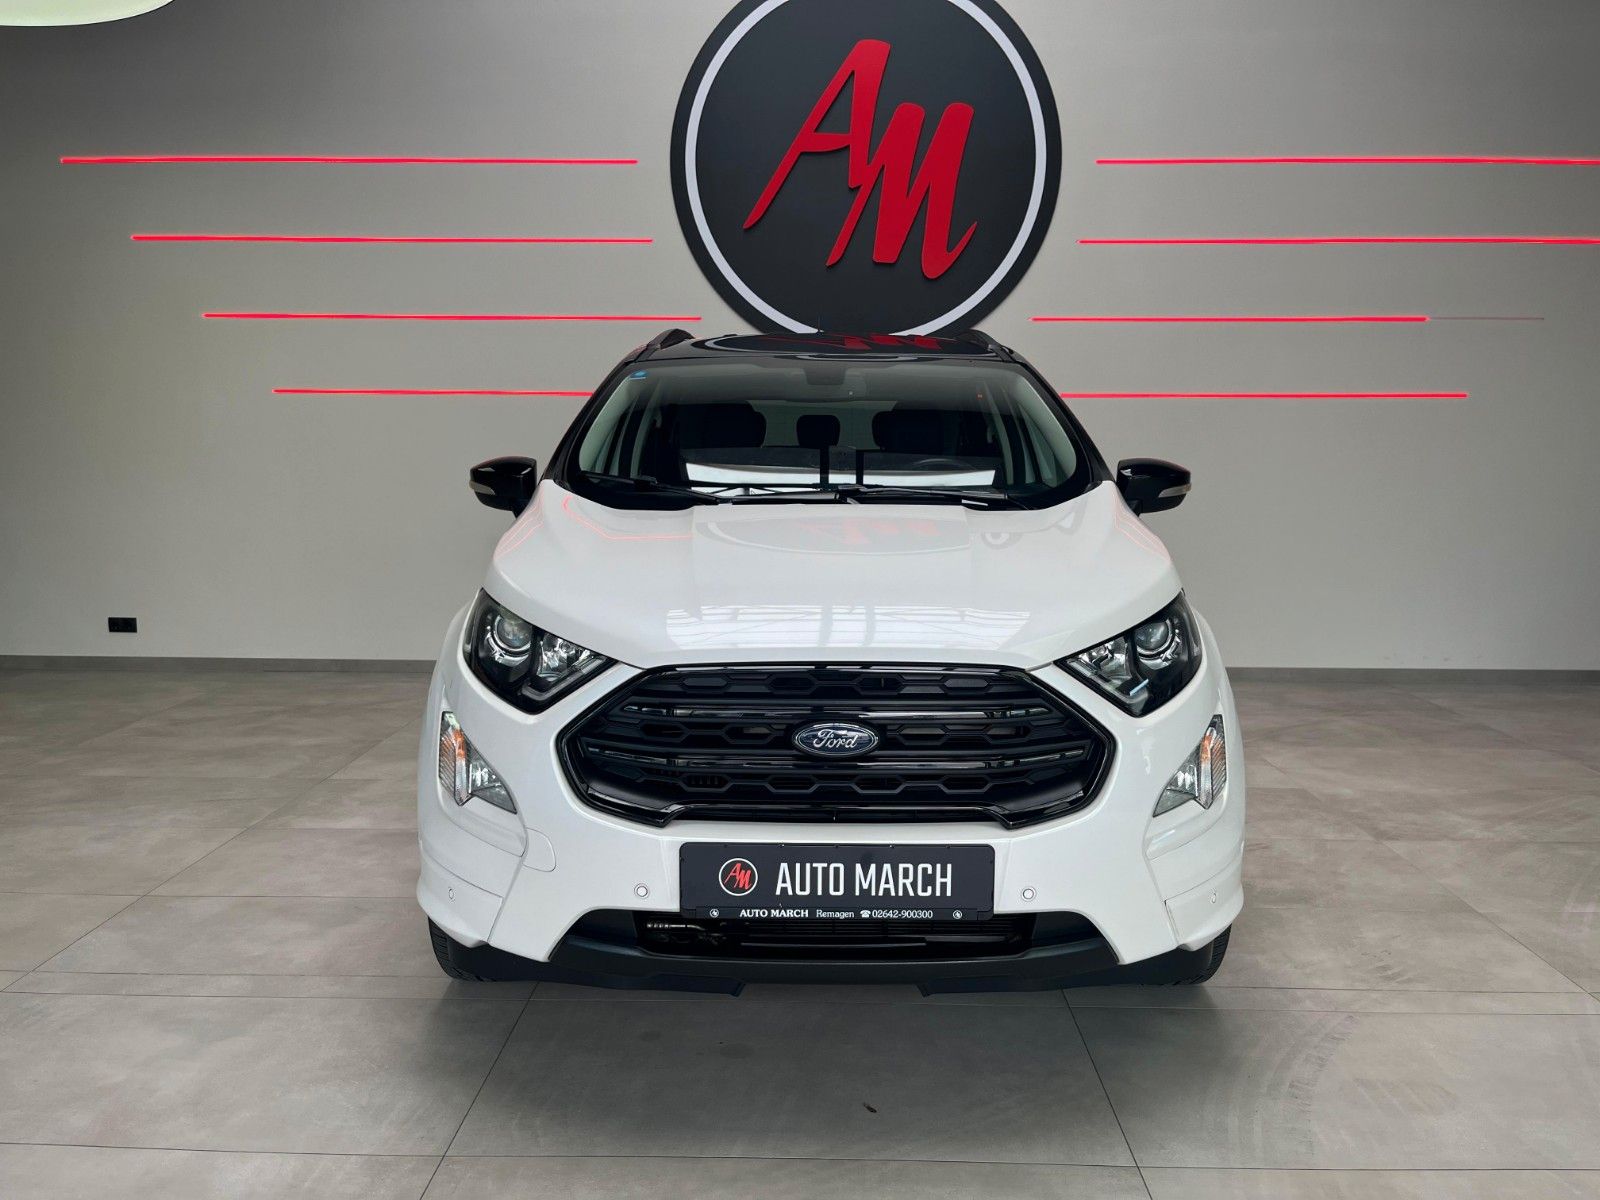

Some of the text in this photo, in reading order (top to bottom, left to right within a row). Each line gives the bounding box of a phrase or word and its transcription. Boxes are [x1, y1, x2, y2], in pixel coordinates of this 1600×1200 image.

[743, 39, 978, 279] AM
[813, 728, 859, 749] Ford
[723, 862, 752, 890] AM
[775, 862, 952, 897] AUTO MARCH
[740, 909, 933, 919] AUTO MARCH Remagen 02642-900300
